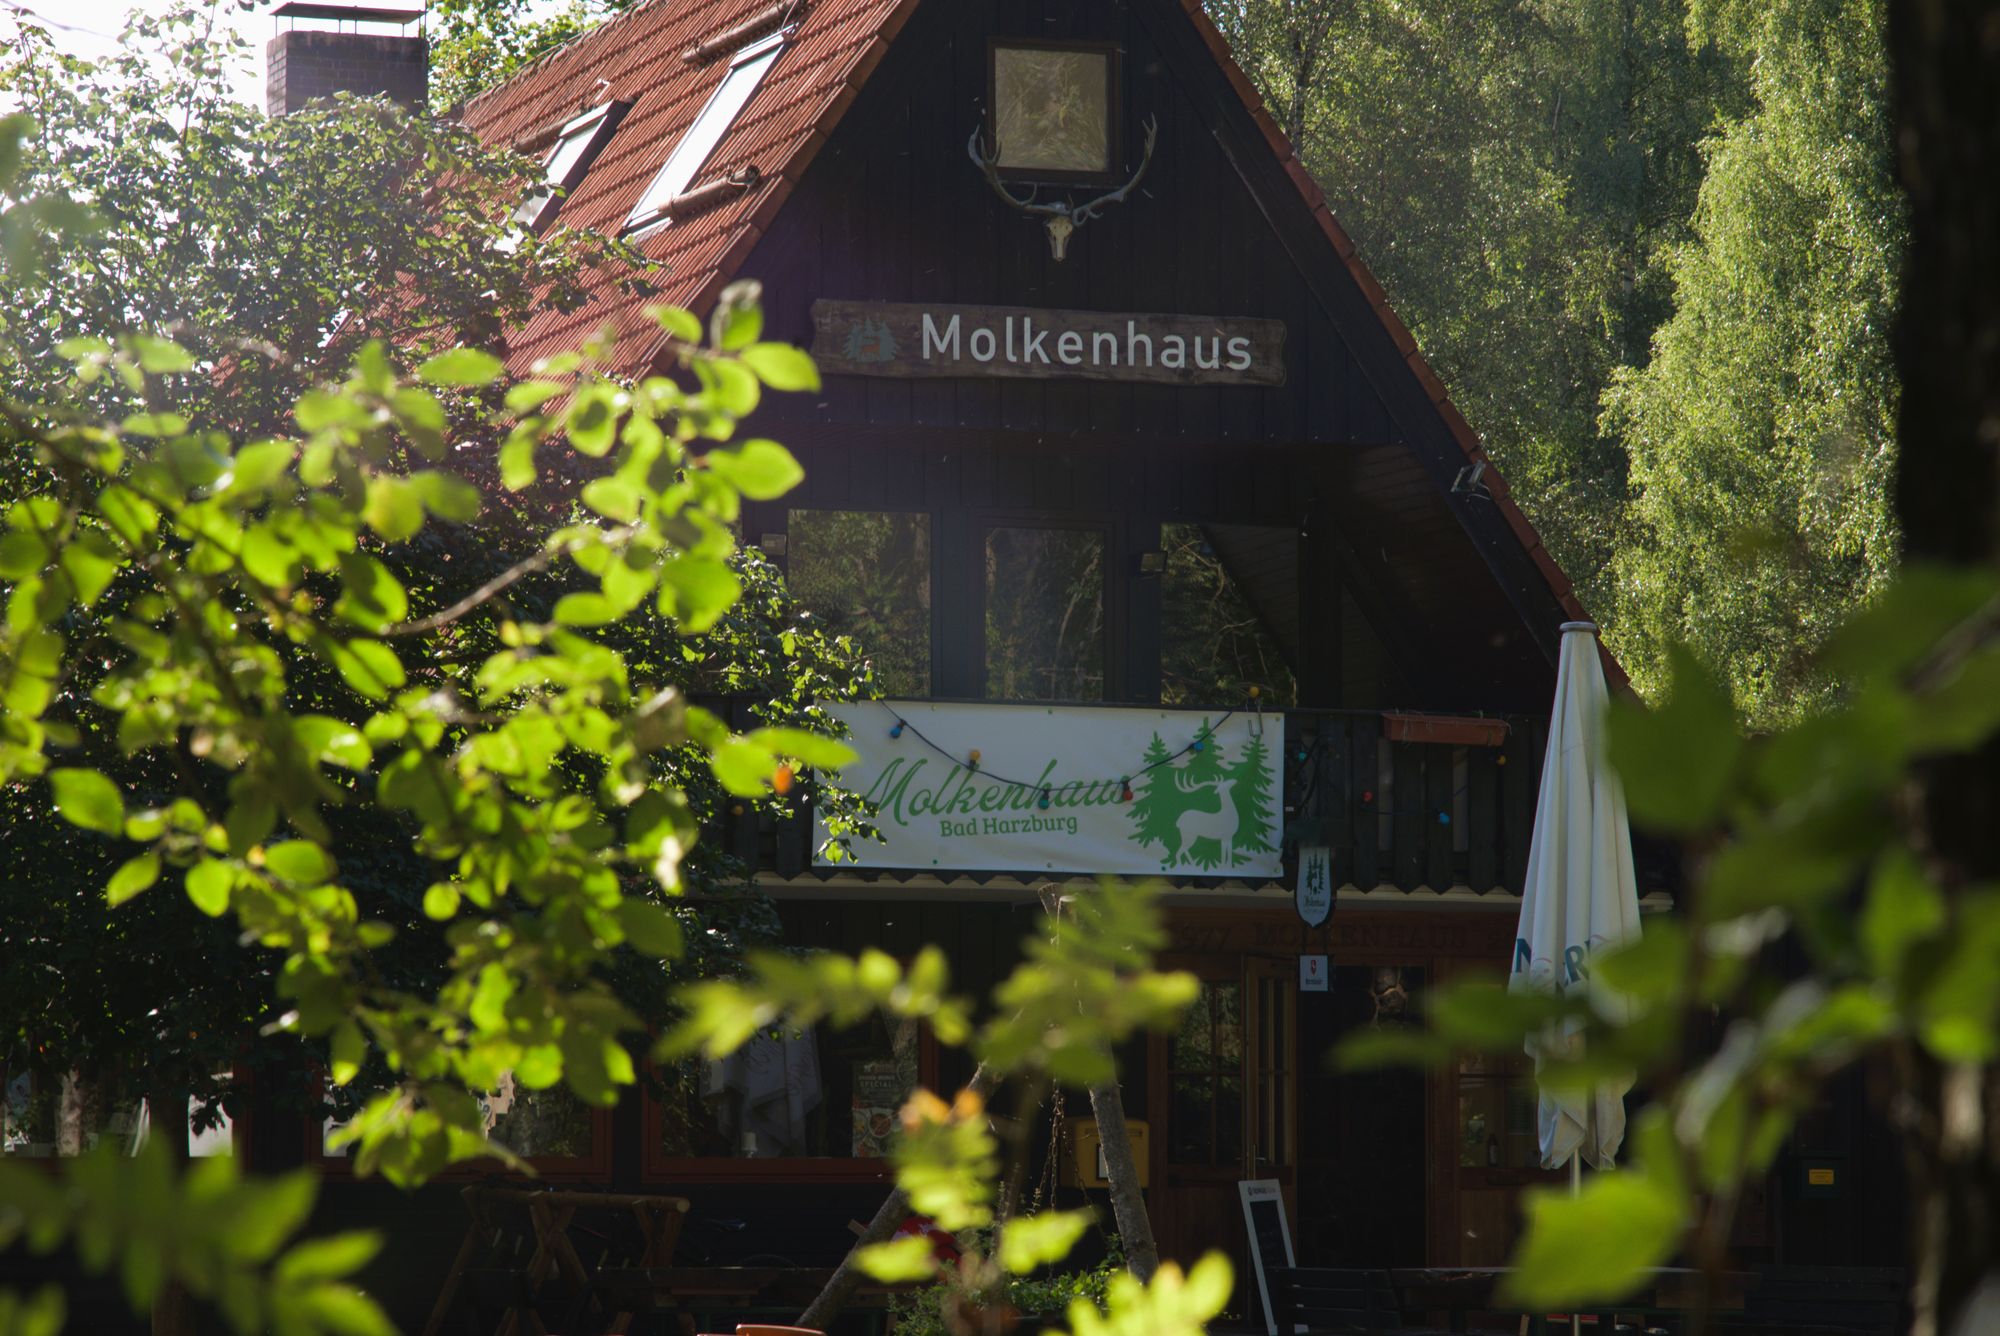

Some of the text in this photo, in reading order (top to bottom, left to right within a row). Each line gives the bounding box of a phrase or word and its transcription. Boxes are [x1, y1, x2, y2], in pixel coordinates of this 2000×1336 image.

[921, 312, 1253, 371] Molkenhaus
[863, 756, 1133, 827] Molkenhaus
[939, 814, 1078, 837] Bad Harzburg
